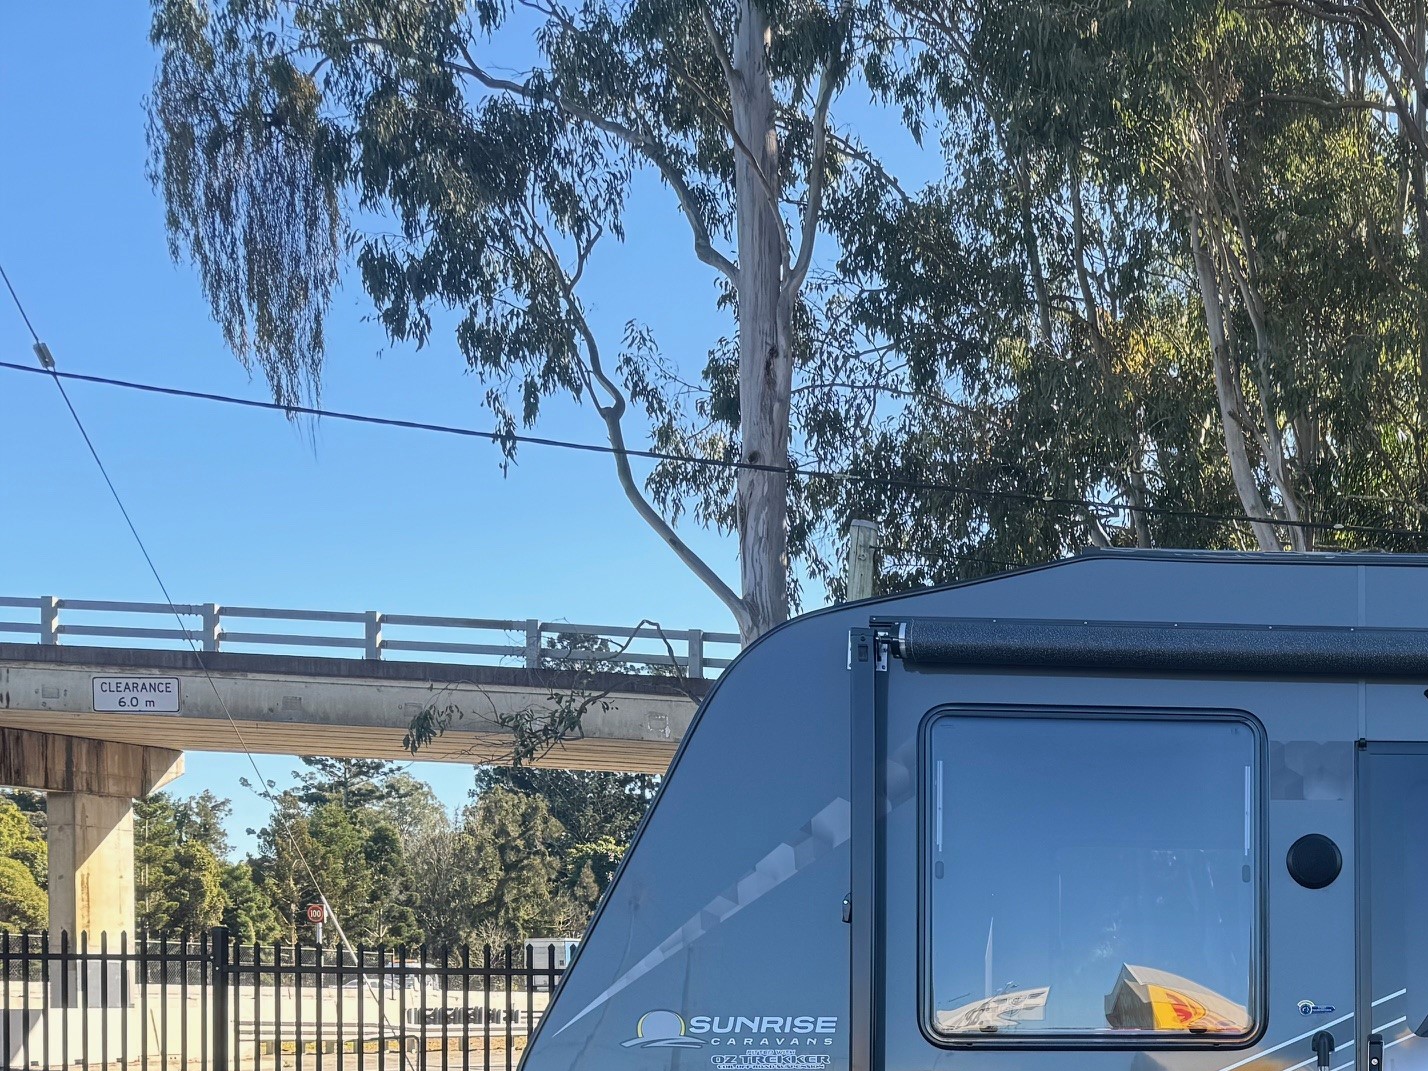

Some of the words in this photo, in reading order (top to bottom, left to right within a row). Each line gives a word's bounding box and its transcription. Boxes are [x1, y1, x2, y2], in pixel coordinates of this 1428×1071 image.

[100, 681, 172, 693] CLEARANCE
[118, 696, 139, 708] 6.0
[145, 699, 155, 708] m
[310, 909, 321, 918] 100
[689, 1016, 838, 1034] SUNRISE
[711, 1055, 738, 1065] OZ
[740, 1055, 831, 1065] TREKKER
